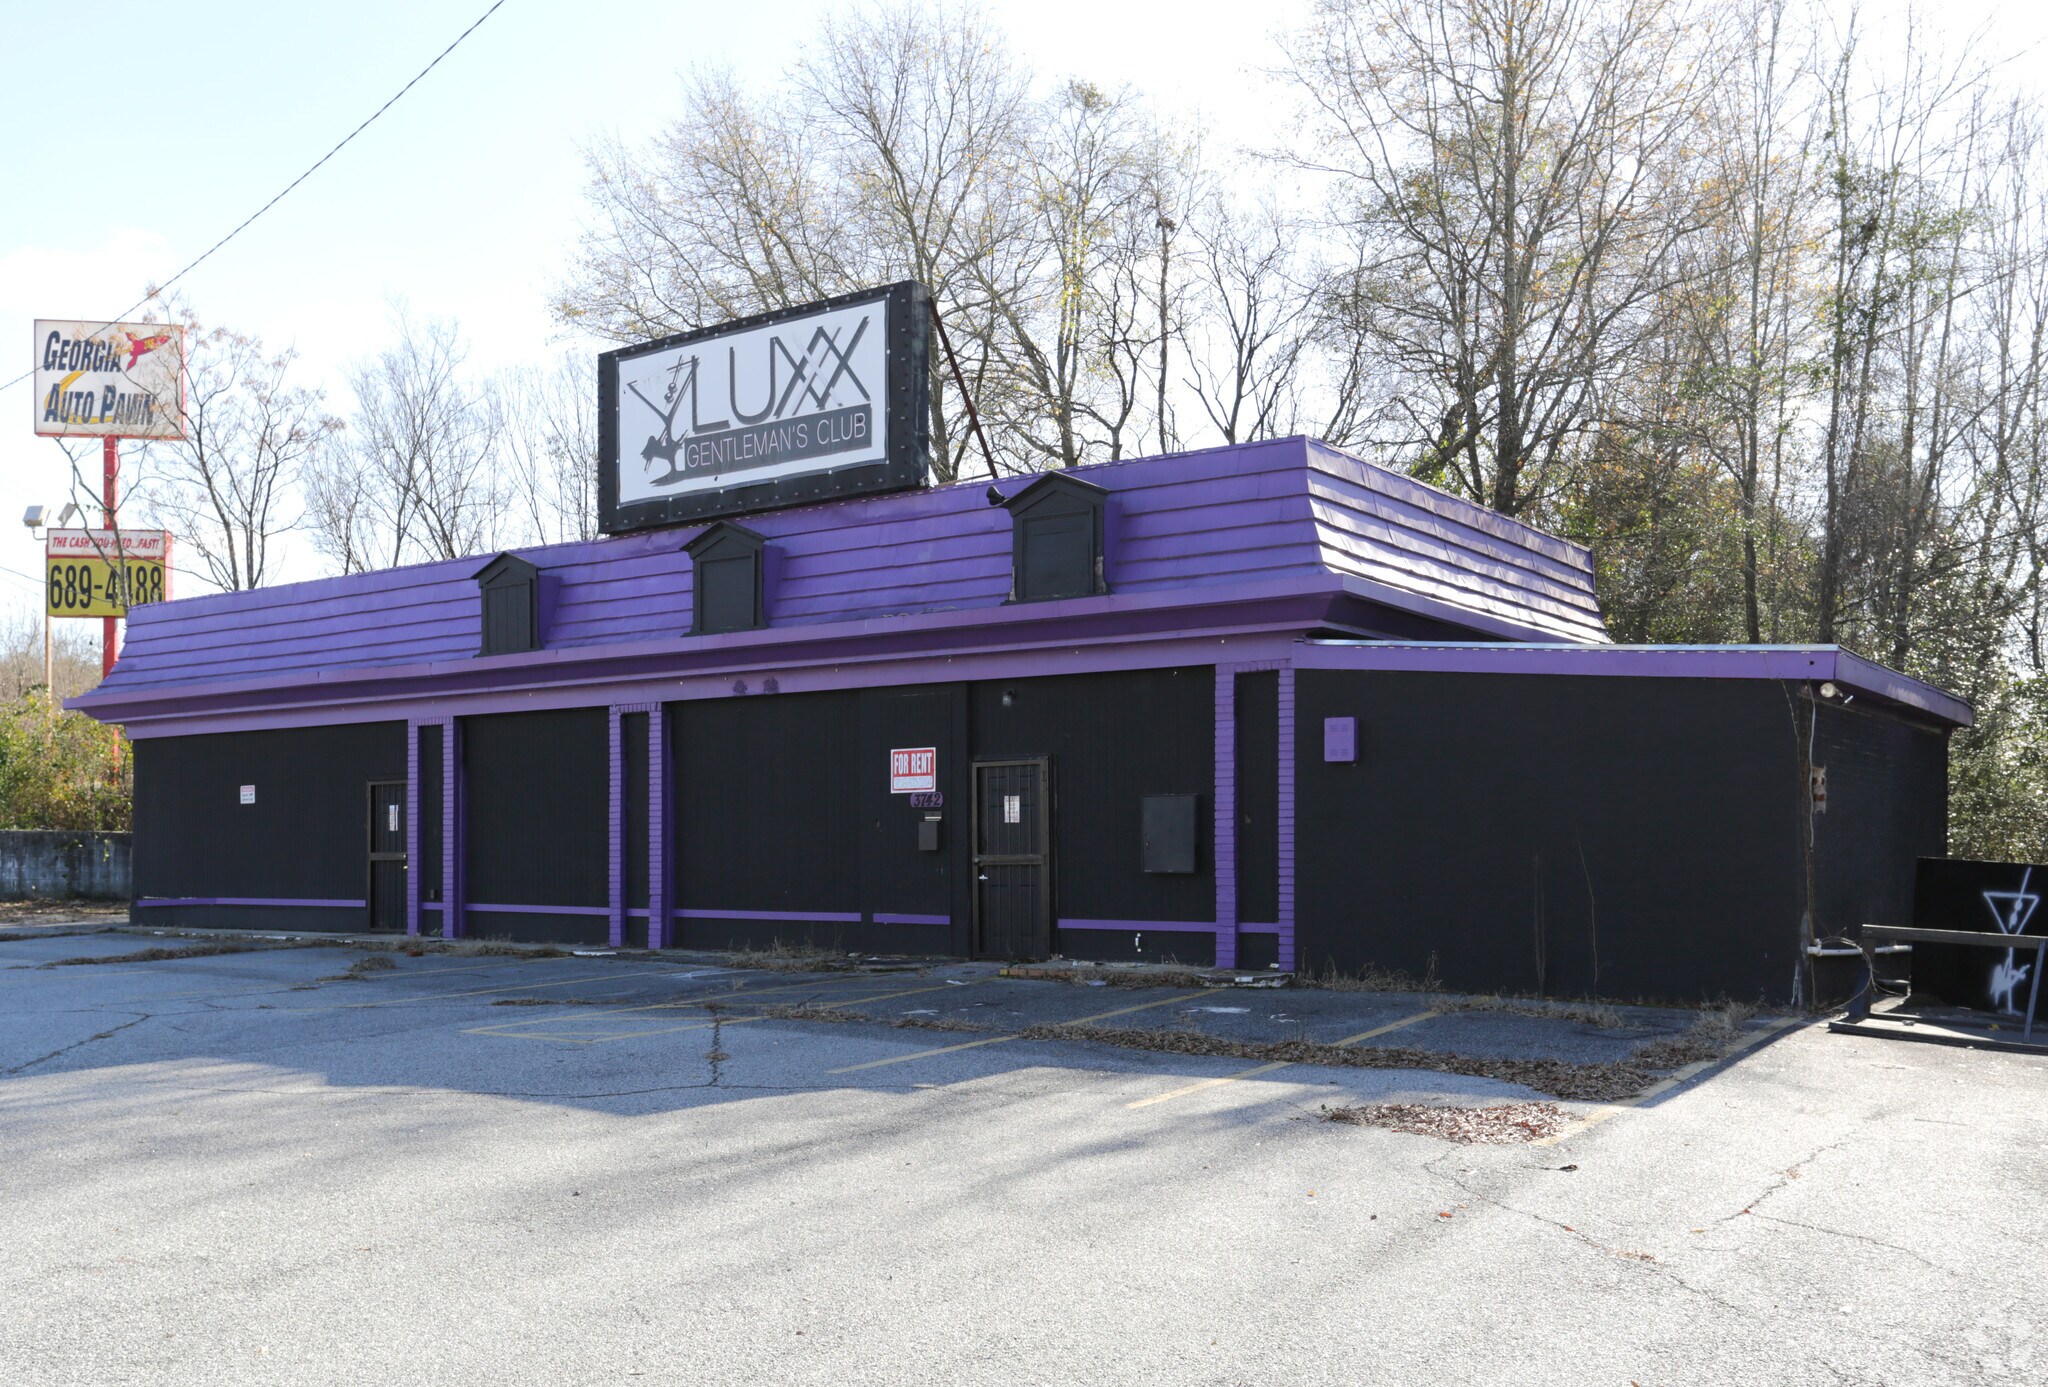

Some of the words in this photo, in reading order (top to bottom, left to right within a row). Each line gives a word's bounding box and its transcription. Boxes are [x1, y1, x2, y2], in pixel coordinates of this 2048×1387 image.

[691, 316, 871, 435] LUXX
[43, 383, 95, 424] AUTO
[99, 385, 156, 425] PAWN
[686, 423, 808, 468] GENTLEMAN'S
[816, 412, 866, 445] CLUB
[52, 537, 68, 547] THE
[69, 537, 90, 548] CASH
[894, 753, 909, 775] FOR
[911, 752, 932, 774] RENT
[913, 793, 941, 807] 3742
